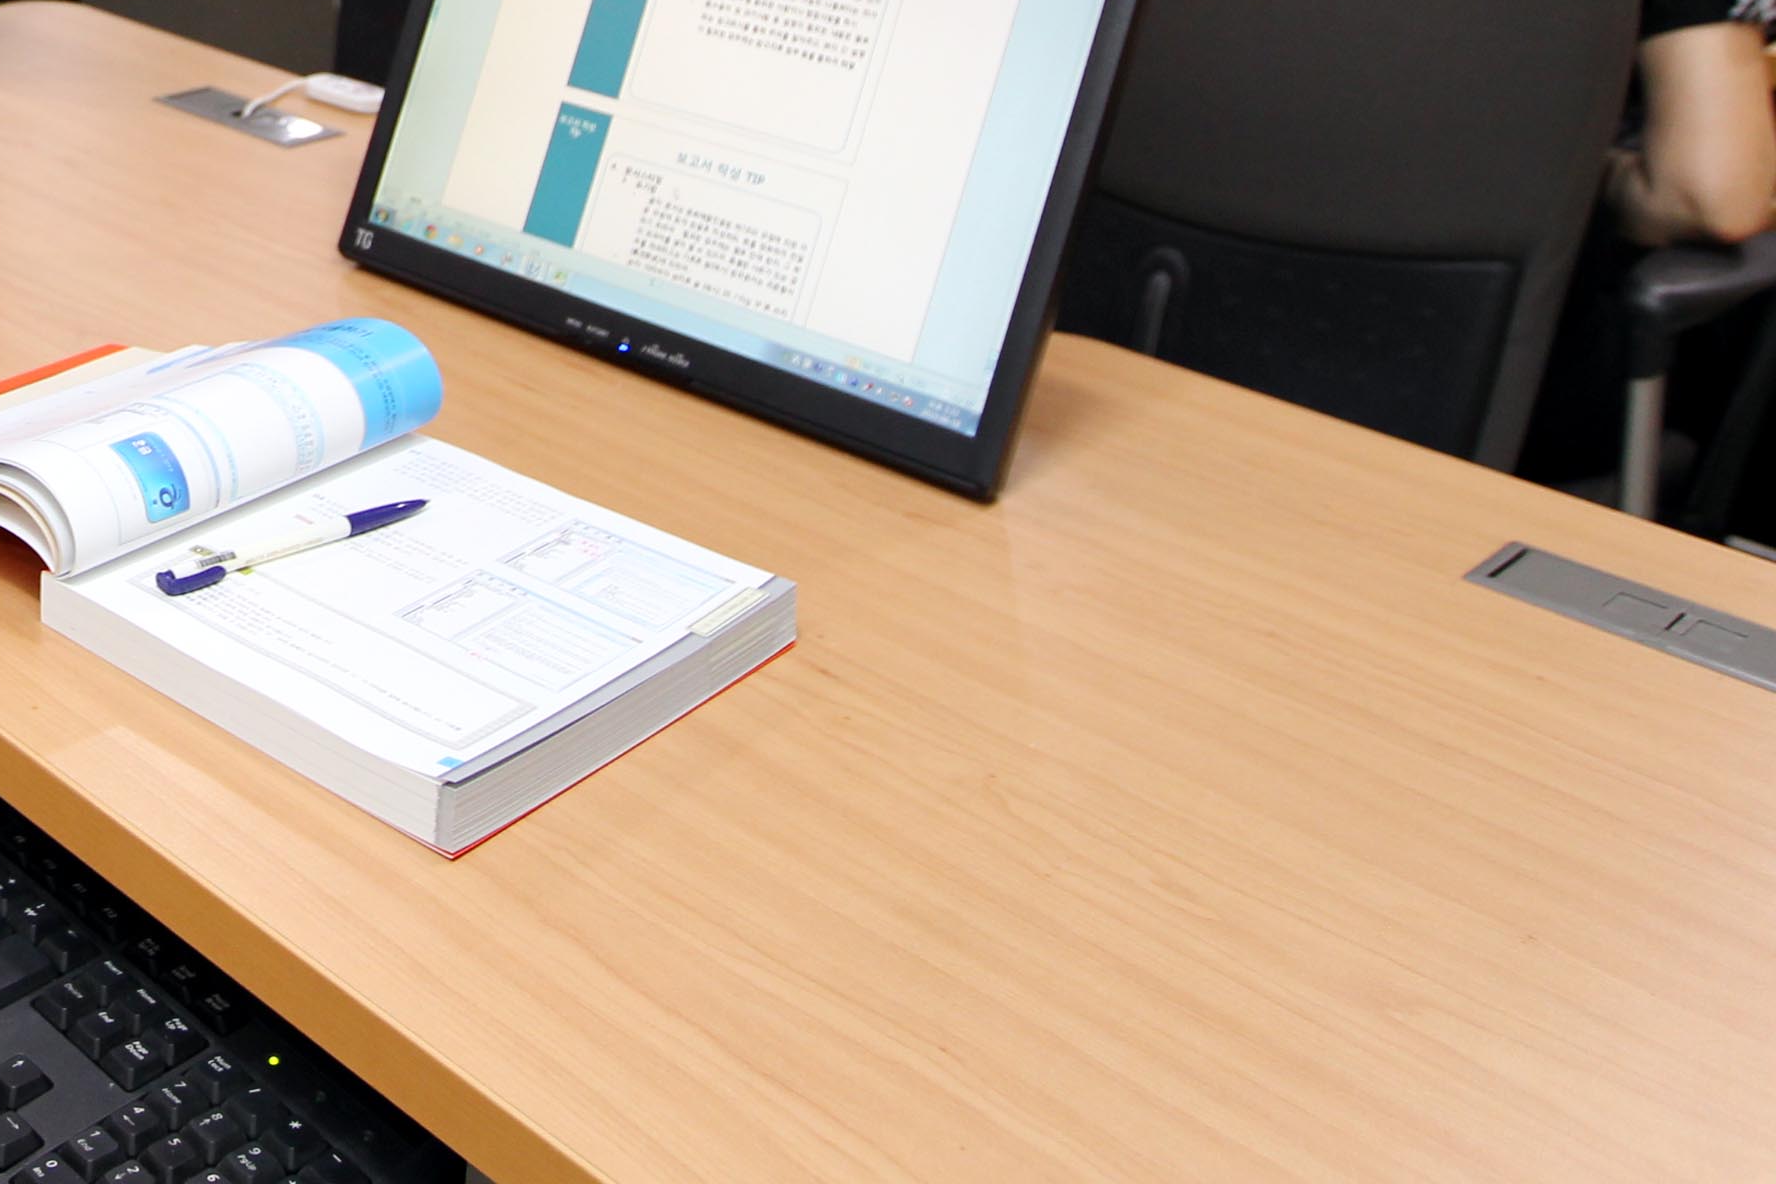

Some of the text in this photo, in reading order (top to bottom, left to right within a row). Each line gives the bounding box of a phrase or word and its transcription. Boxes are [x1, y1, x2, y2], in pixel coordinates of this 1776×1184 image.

[676, 151, 715, 173] 보고서
[745, 171, 767, 187] TIP
[353, 227, 374, 250] TG
